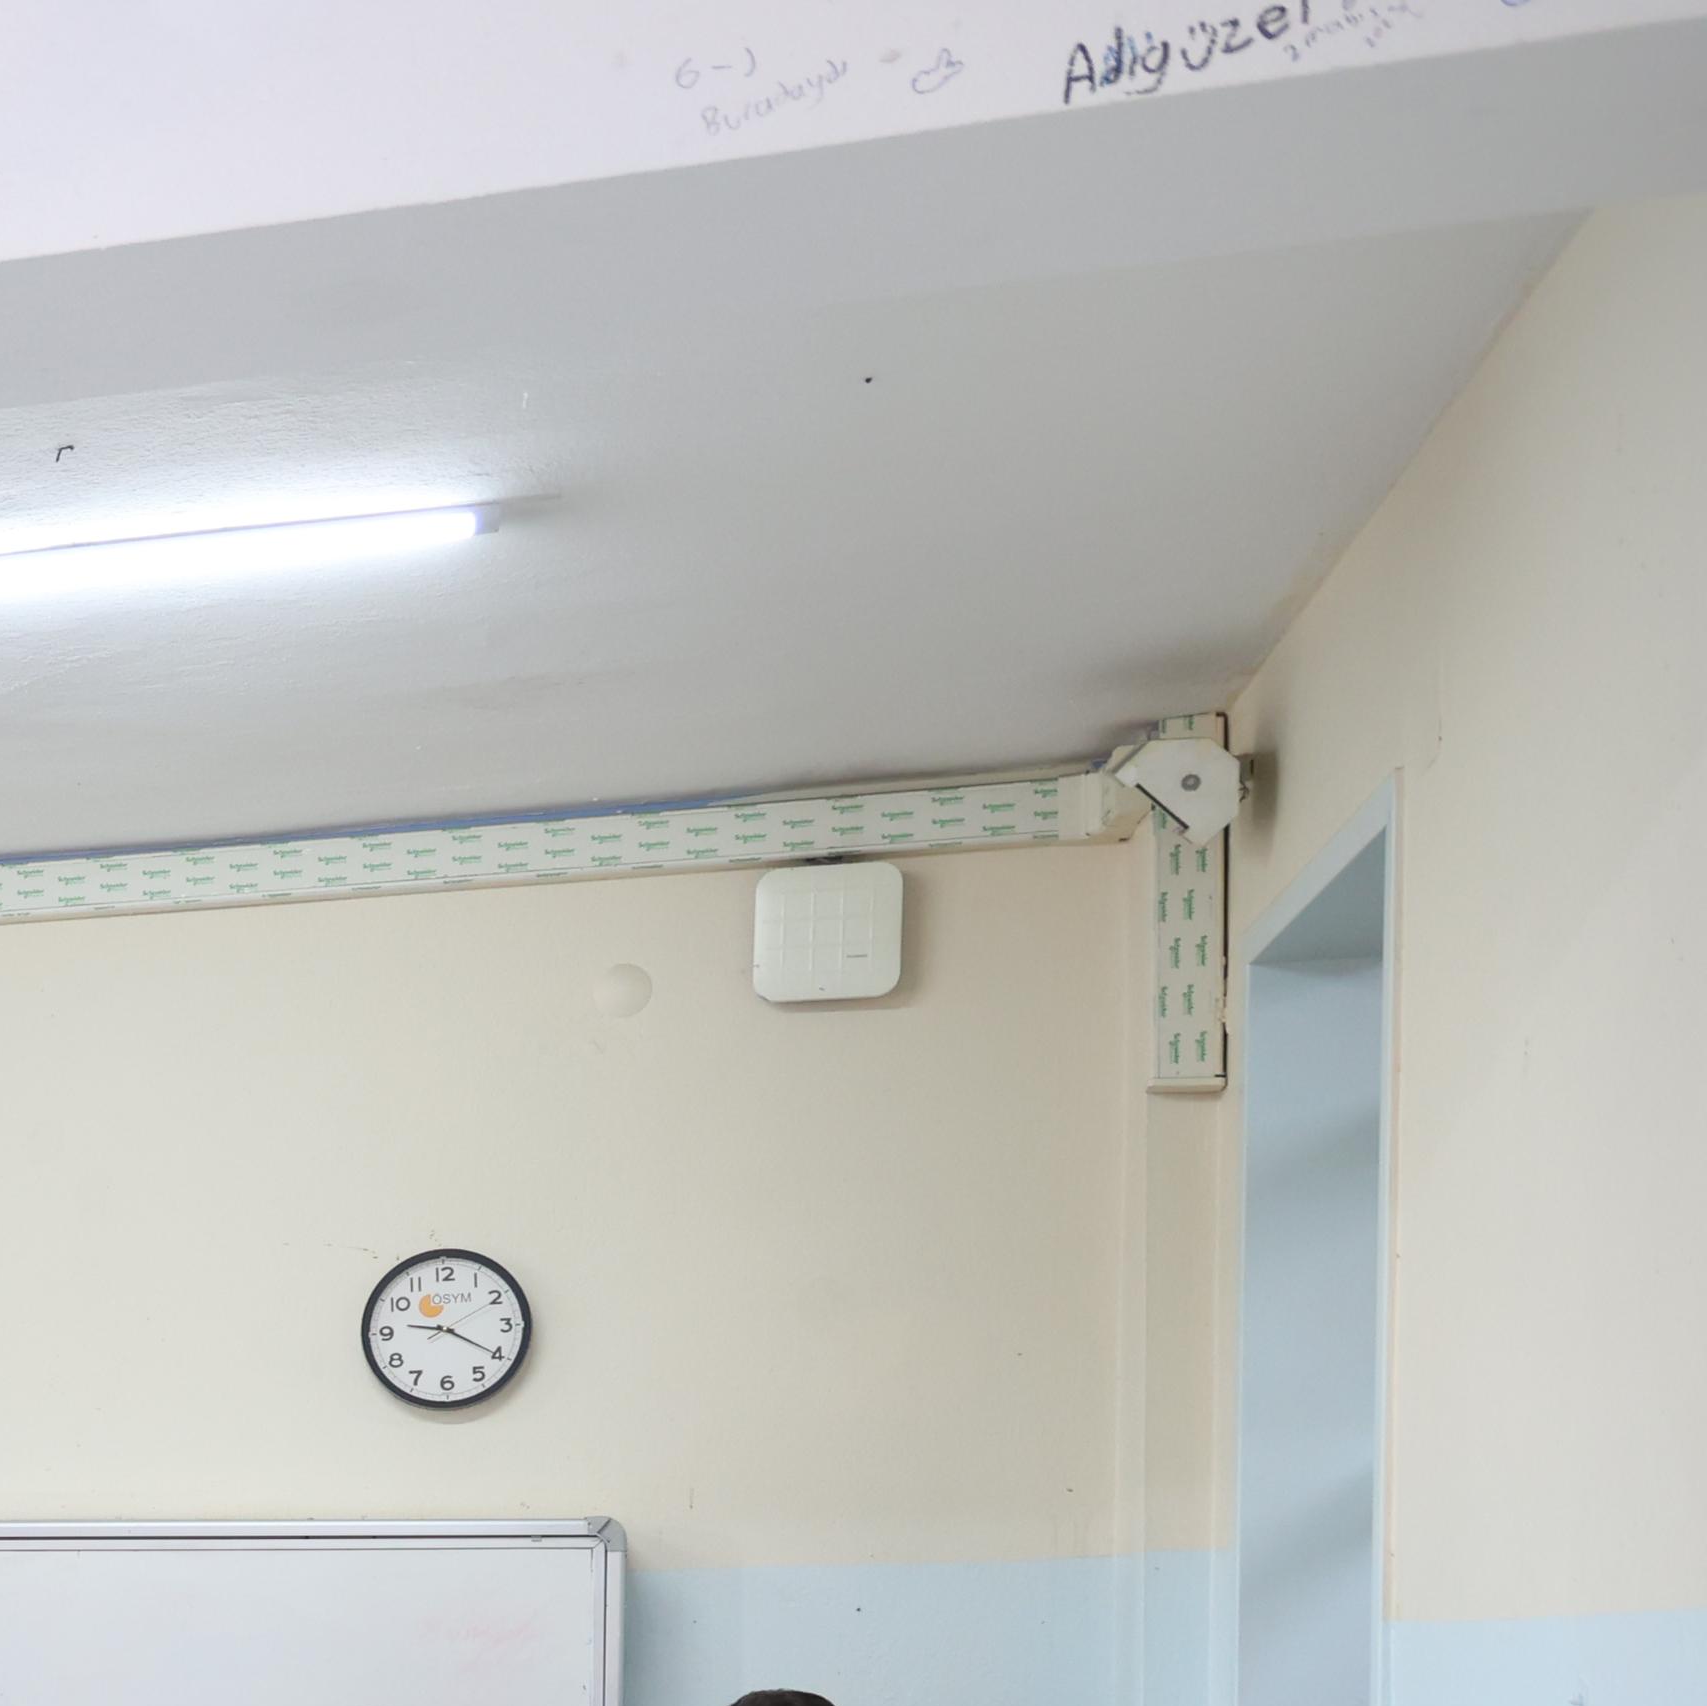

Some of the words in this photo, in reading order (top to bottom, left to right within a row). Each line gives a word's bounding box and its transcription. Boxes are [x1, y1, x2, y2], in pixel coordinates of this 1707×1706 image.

[436, 1267, 455, 1282] 12
[474, 1272, 478, 1288] 1
[410, 1276, 422, 1292] 11
[390, 1296, 411, 1312] 10
[488, 1290, 503, 1305] 2
[379, 1326, 394, 1341] 9
[500, 1318, 513, 1333] 3
[388, 1352, 404, 1368] 8
[491, 1346, 505, 1361] 4
[409, 1370, 423, 1386] 7
[472, 1366, 486, 1382] 5
[440, 1375, 455, 1391] 6
